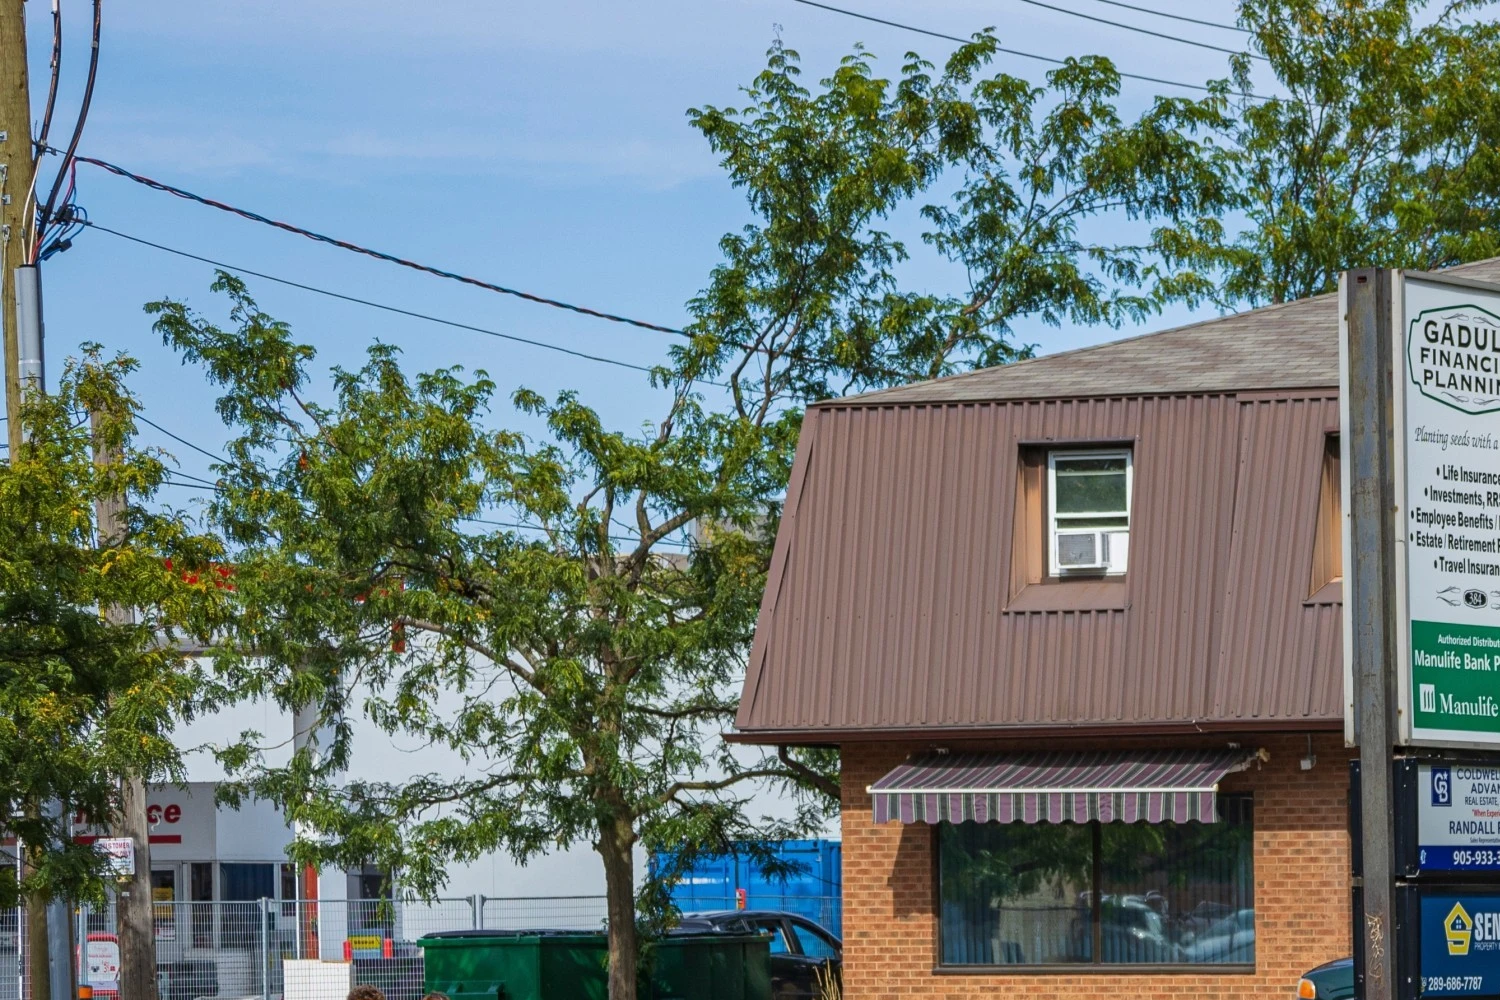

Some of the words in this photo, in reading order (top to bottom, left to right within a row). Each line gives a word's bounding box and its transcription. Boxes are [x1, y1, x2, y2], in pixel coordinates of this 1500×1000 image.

[1415, 425, 1448, 451] Planting
[1450, 430, 1470, 446] seeds
[1471, 432, 1492, 450] with
[1493, 439, 1498, 450] a
[1442, 464, 1458, 481] Life
[1430, 485, 1485, 510] Investments,
[1416, 507, 1456, 530] Employee
[1458, 512, 1494, 530] Benefits
[1416, 531, 1442, 548] Estate
[1448, 534, 1496, 553] Retirement
[1439, 556, 1466, 573] Travel
[1438, 634, 1471, 646] Authorized
[1414, 649, 1461, 669] Manulife
[1464, 653, 1491, 671] Bank
[1439, 693, 1498, 717] Manulife
[1465, 797, 1478, 805] REAL
[1480, 797, 1499, 806] ESTATE,
[1449, 821, 1495, 834] RANDALL
[1475, 942, 1498, 950] PROPERTY
[1429, 976, 1482, 990] 289-686-7787
